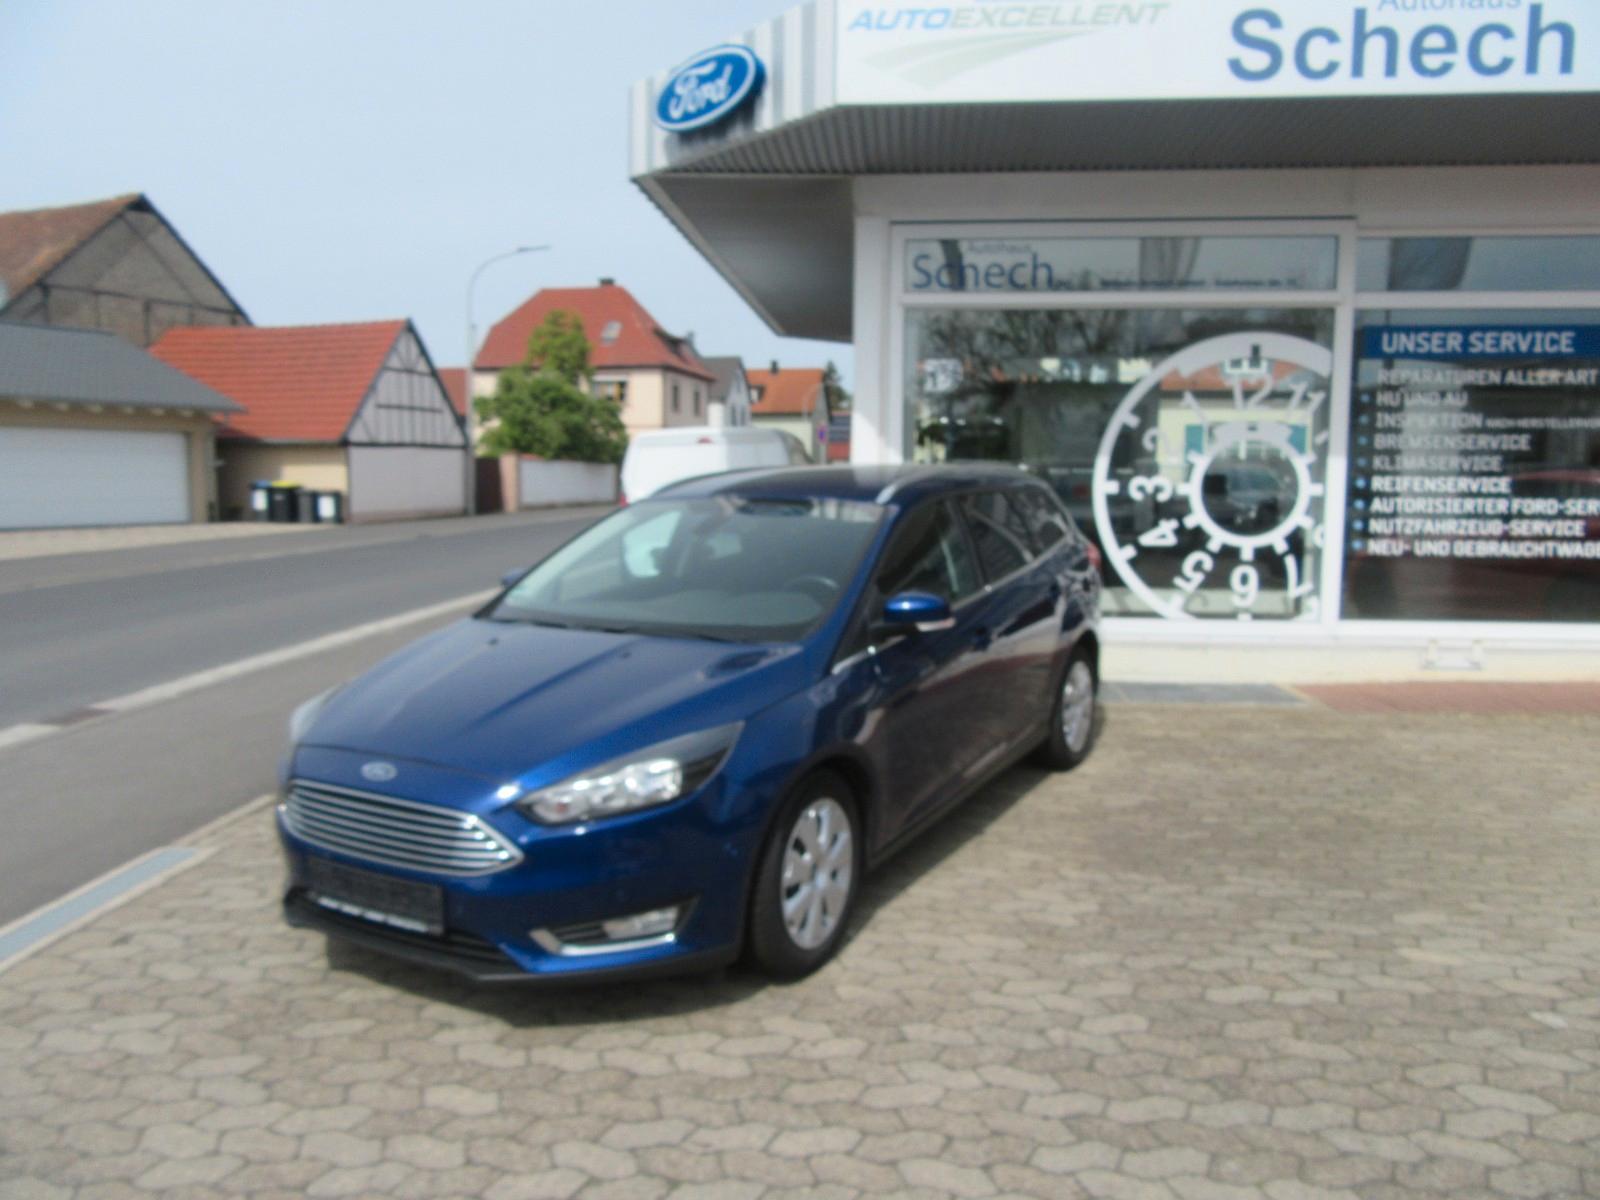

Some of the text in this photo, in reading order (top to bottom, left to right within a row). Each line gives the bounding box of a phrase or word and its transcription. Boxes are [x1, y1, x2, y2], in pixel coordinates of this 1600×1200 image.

[847, 3, 1170, 31] AUTOEXCELLENT
[1228, 3, 1576, 82] Schech
[668, 59, 732, 120] Ford
[911, 252, 1053, 290] Schech
[1382, 331, 1576, 353] UNSER SERVICE
[1564, 368, 1598, 385] ART
[1370, 476, 1512, 494] REIFENSERVICE
[1369, 496, 1509, 515] AUTORISIERTER
[1367, 517, 1586, 537] NUTZFAHRZEUG-SERVICE
[1366, 538, 1411, 557] NEU-
[1413, 539, 1451, 558] UND
